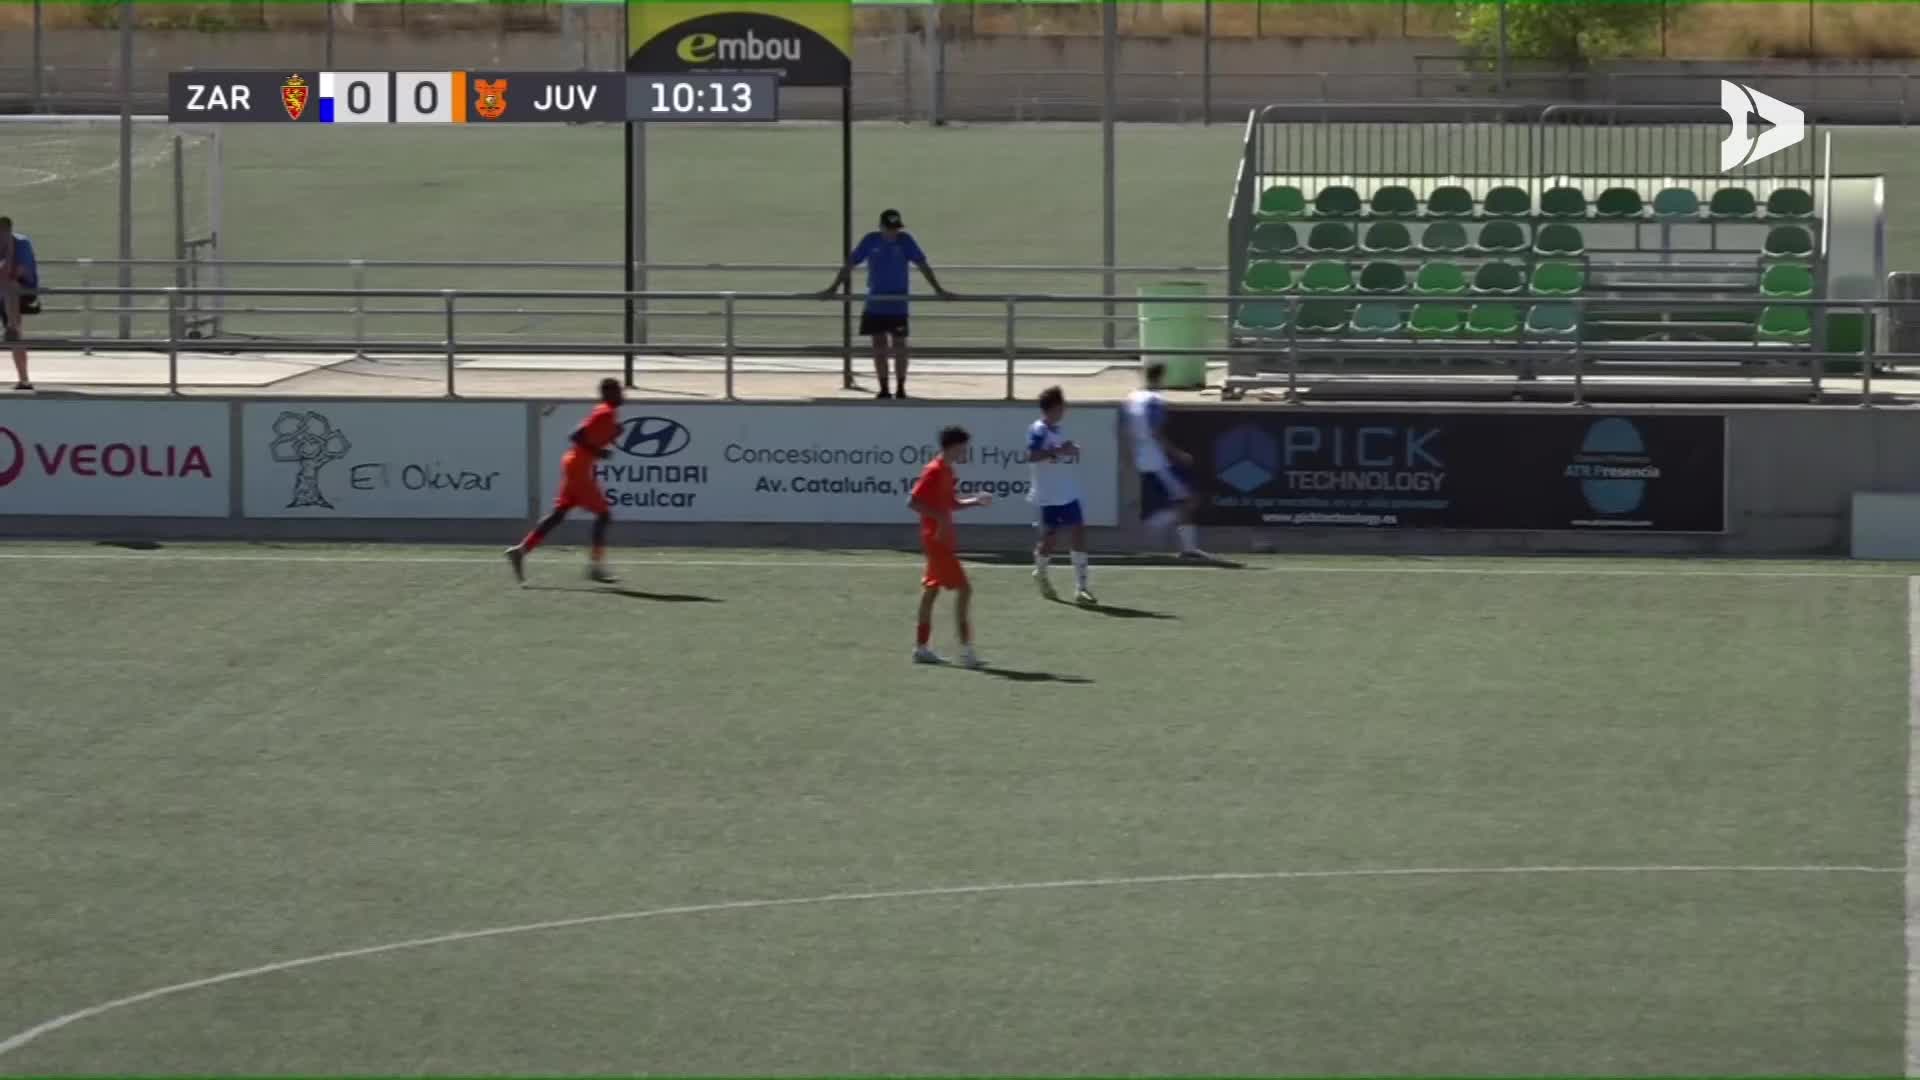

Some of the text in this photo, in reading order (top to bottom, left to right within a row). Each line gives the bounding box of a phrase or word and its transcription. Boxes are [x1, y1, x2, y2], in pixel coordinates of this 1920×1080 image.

[677, 31, 800, 63] embou
[725, 444, 893, 465] Concesionario
[1285, 425, 1444, 468] PICK
[35, 443, 213, 478] VEOLIA
[402, 461, 499, 491] Olivar
[593, 465, 708, 484] HYUNDAI
[1286, 470, 1446, 491] TECHNOLOGY
[755, 476, 787, 493] Av.
[791, 475, 897, 497] Cataluña,
[606, 488, 696, 507] Seulcar
